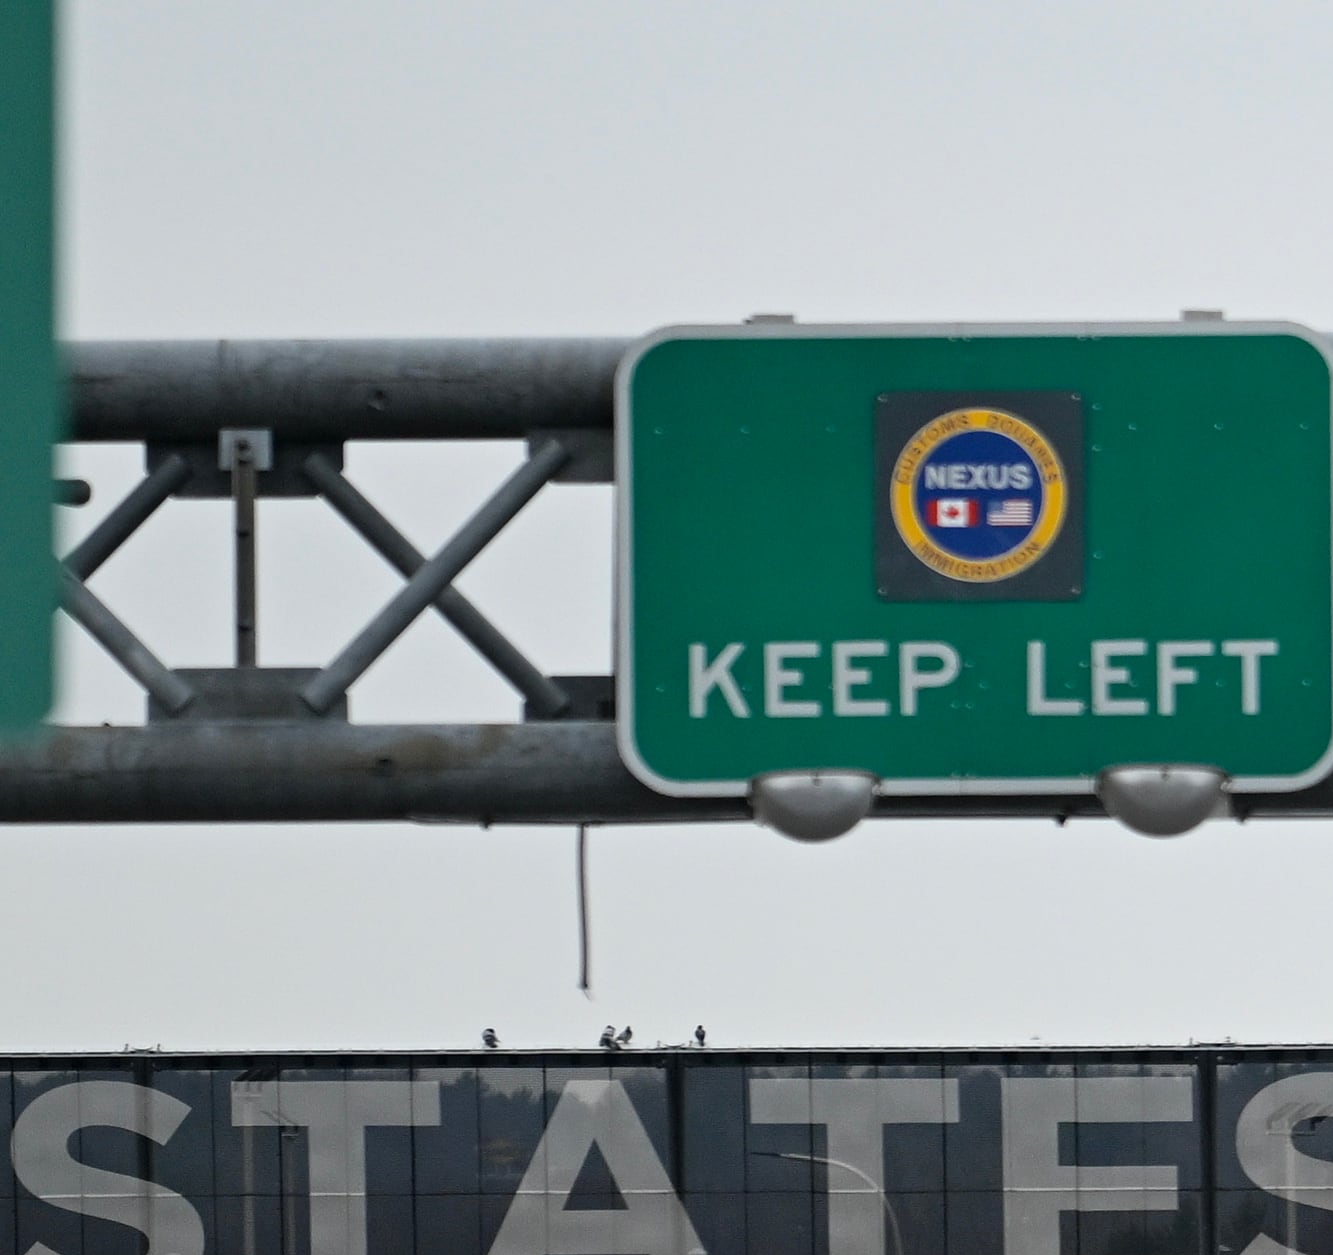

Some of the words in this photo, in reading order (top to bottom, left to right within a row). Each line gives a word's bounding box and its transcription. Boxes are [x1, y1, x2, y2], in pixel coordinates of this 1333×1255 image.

[896, 414, 969, 485] CUSTOMS
[924, 463, 1033, 490] NEXUS
[987, 414, 1058, 483] DOUANES
[915, 541, 1042, 577] IMMIGRATION
[688, 640, 962, 719] KEEP
[1026, 639, 1279, 718] LEFT
